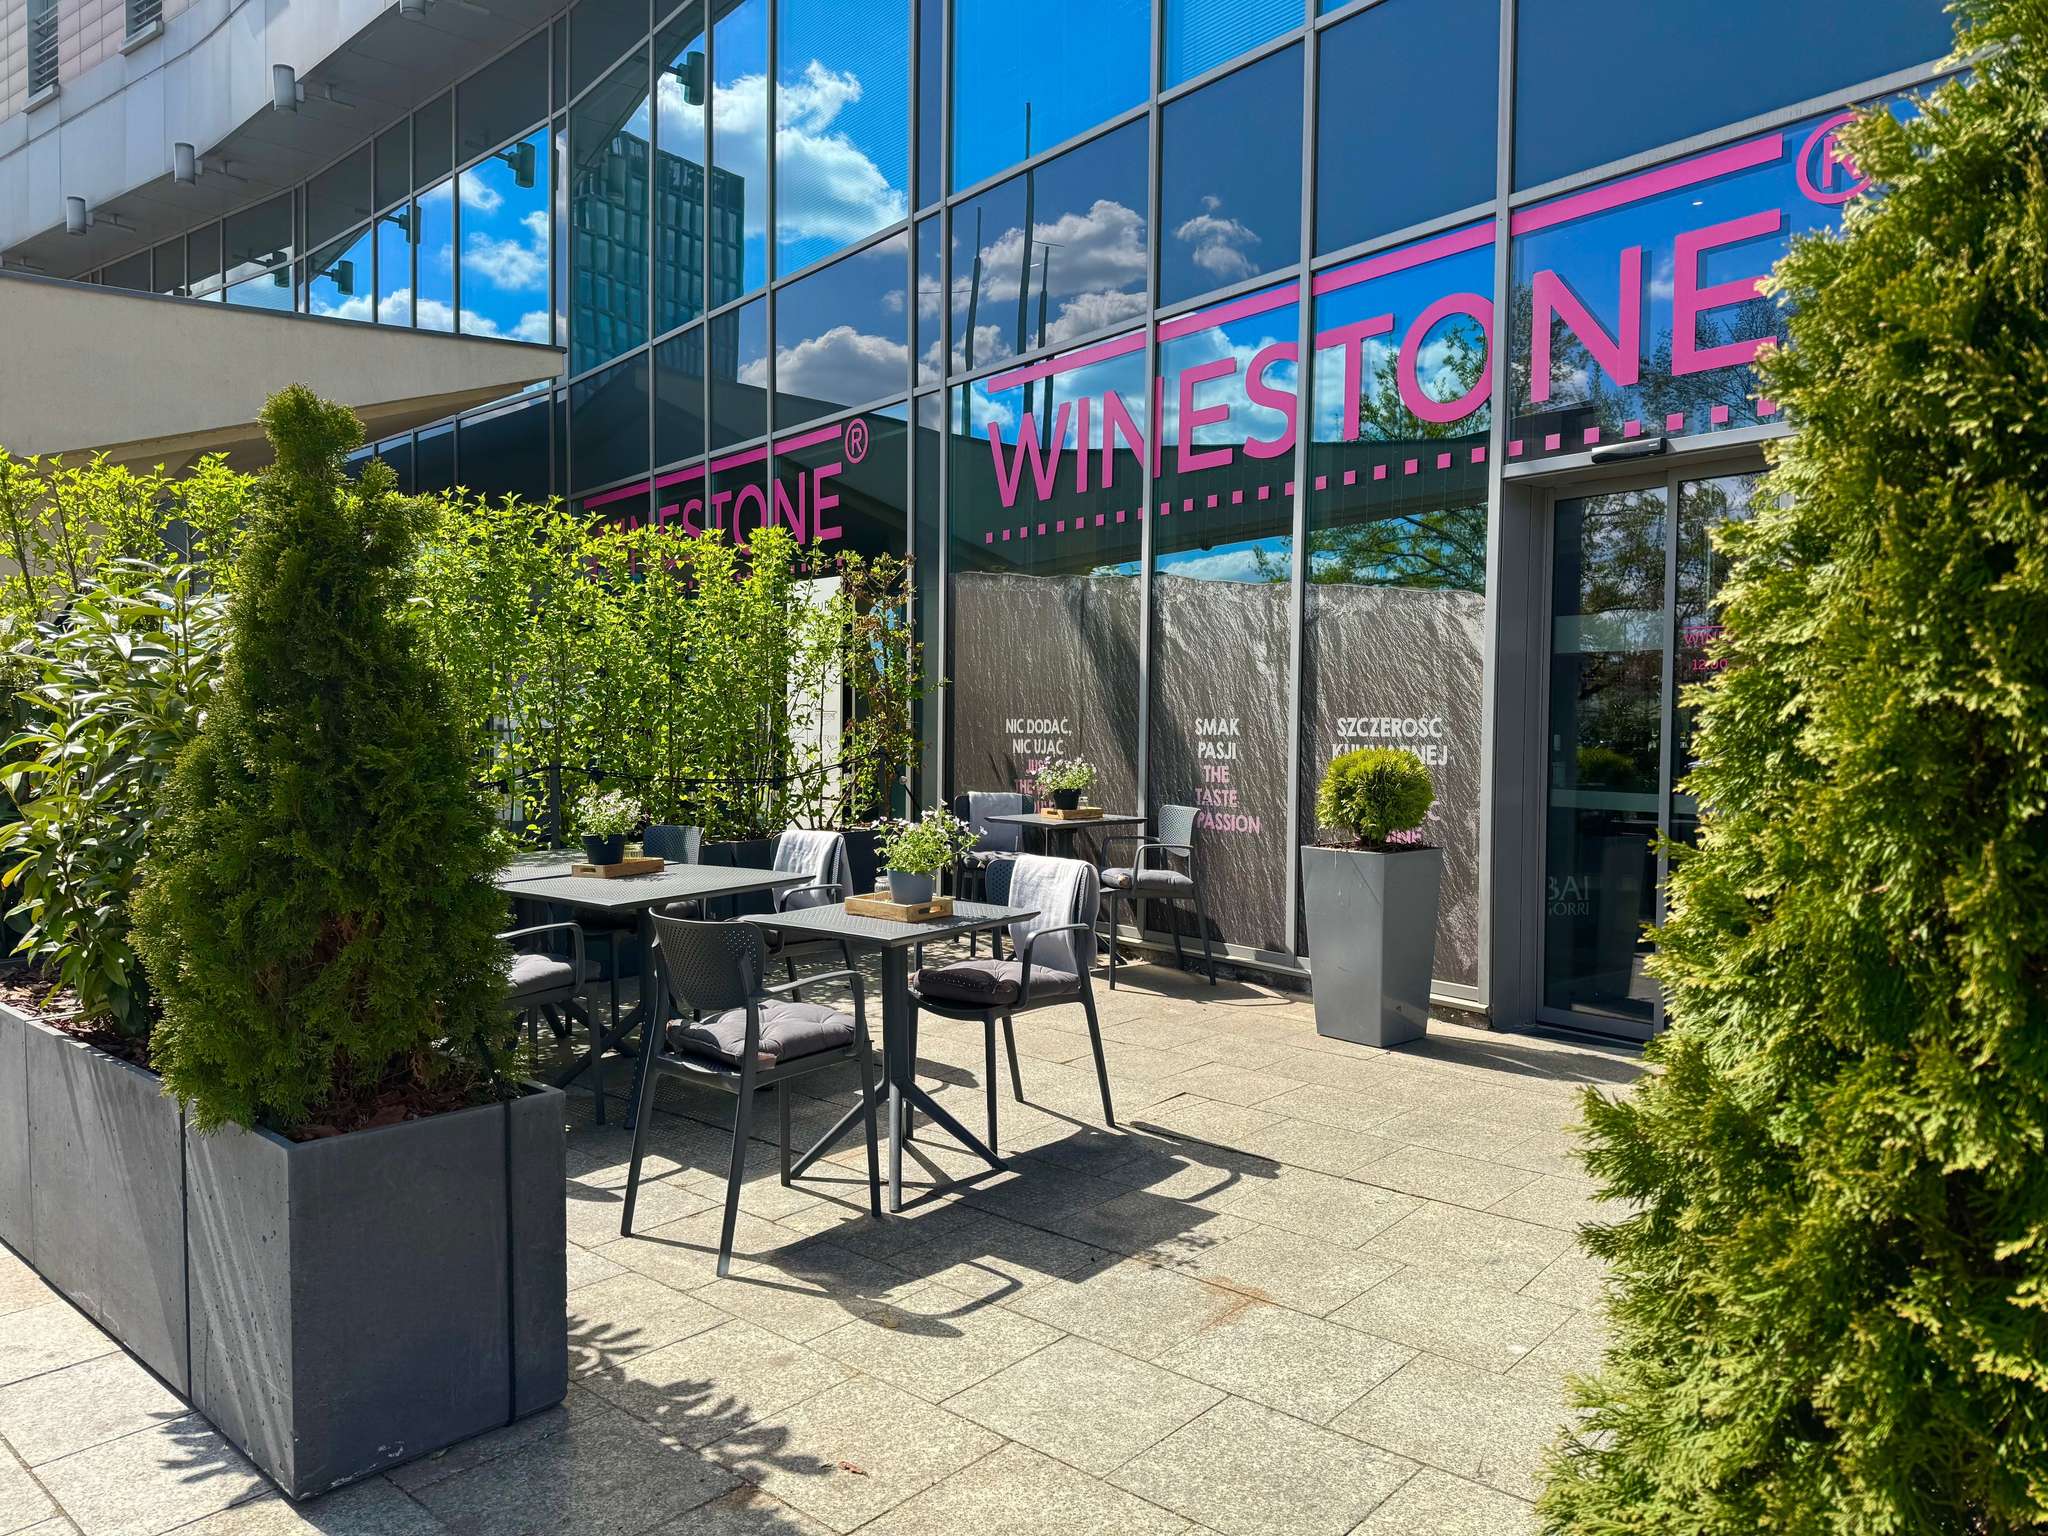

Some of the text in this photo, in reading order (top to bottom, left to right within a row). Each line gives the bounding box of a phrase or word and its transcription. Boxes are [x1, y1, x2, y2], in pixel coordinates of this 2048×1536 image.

[1005, 718, 1024, 734] NIC
[1194, 718, 1240, 736] SMAK
[1337, 714, 1443, 738] SZCZEROŚĆ
[1012, 738, 1031, 754] NIC
[1198, 741, 1238, 760] PASJI
[1203, 764, 1230, 783] THE
[1194, 786, 1238, 808] TASTE
[1197, 812, 1261, 834] PASSION
[1547, 901, 1590, 916] ORRI
